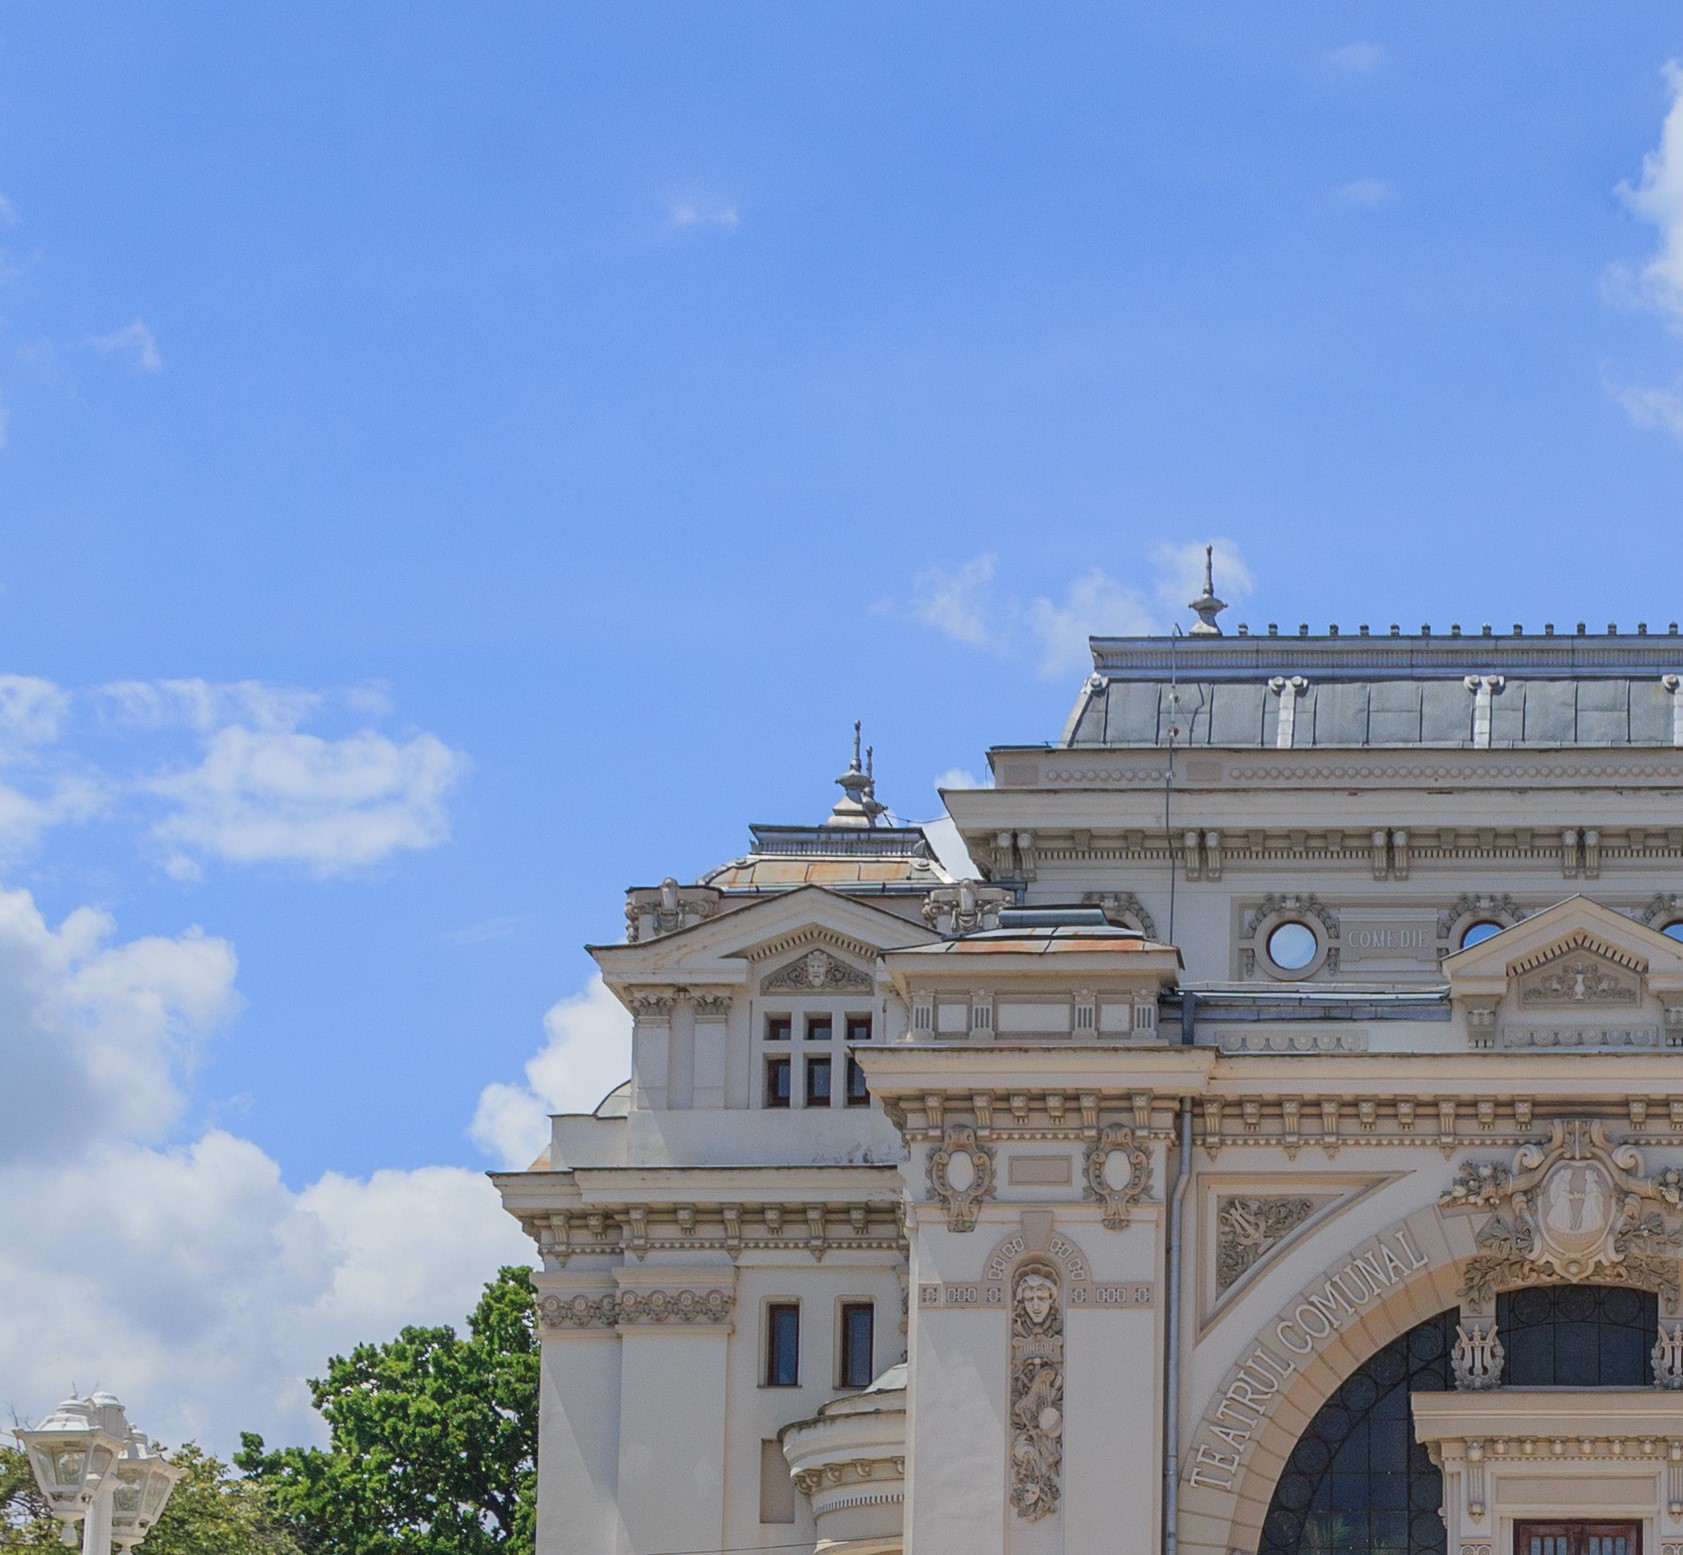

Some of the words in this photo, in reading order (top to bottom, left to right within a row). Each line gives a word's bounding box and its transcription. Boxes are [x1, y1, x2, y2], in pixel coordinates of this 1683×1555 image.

[1348, 930, 1428, 948] COMEDIE
[1190, 1348, 1296, 1490] TEATRUL
[1276, 1231, 1429, 1354] COMUNAL
